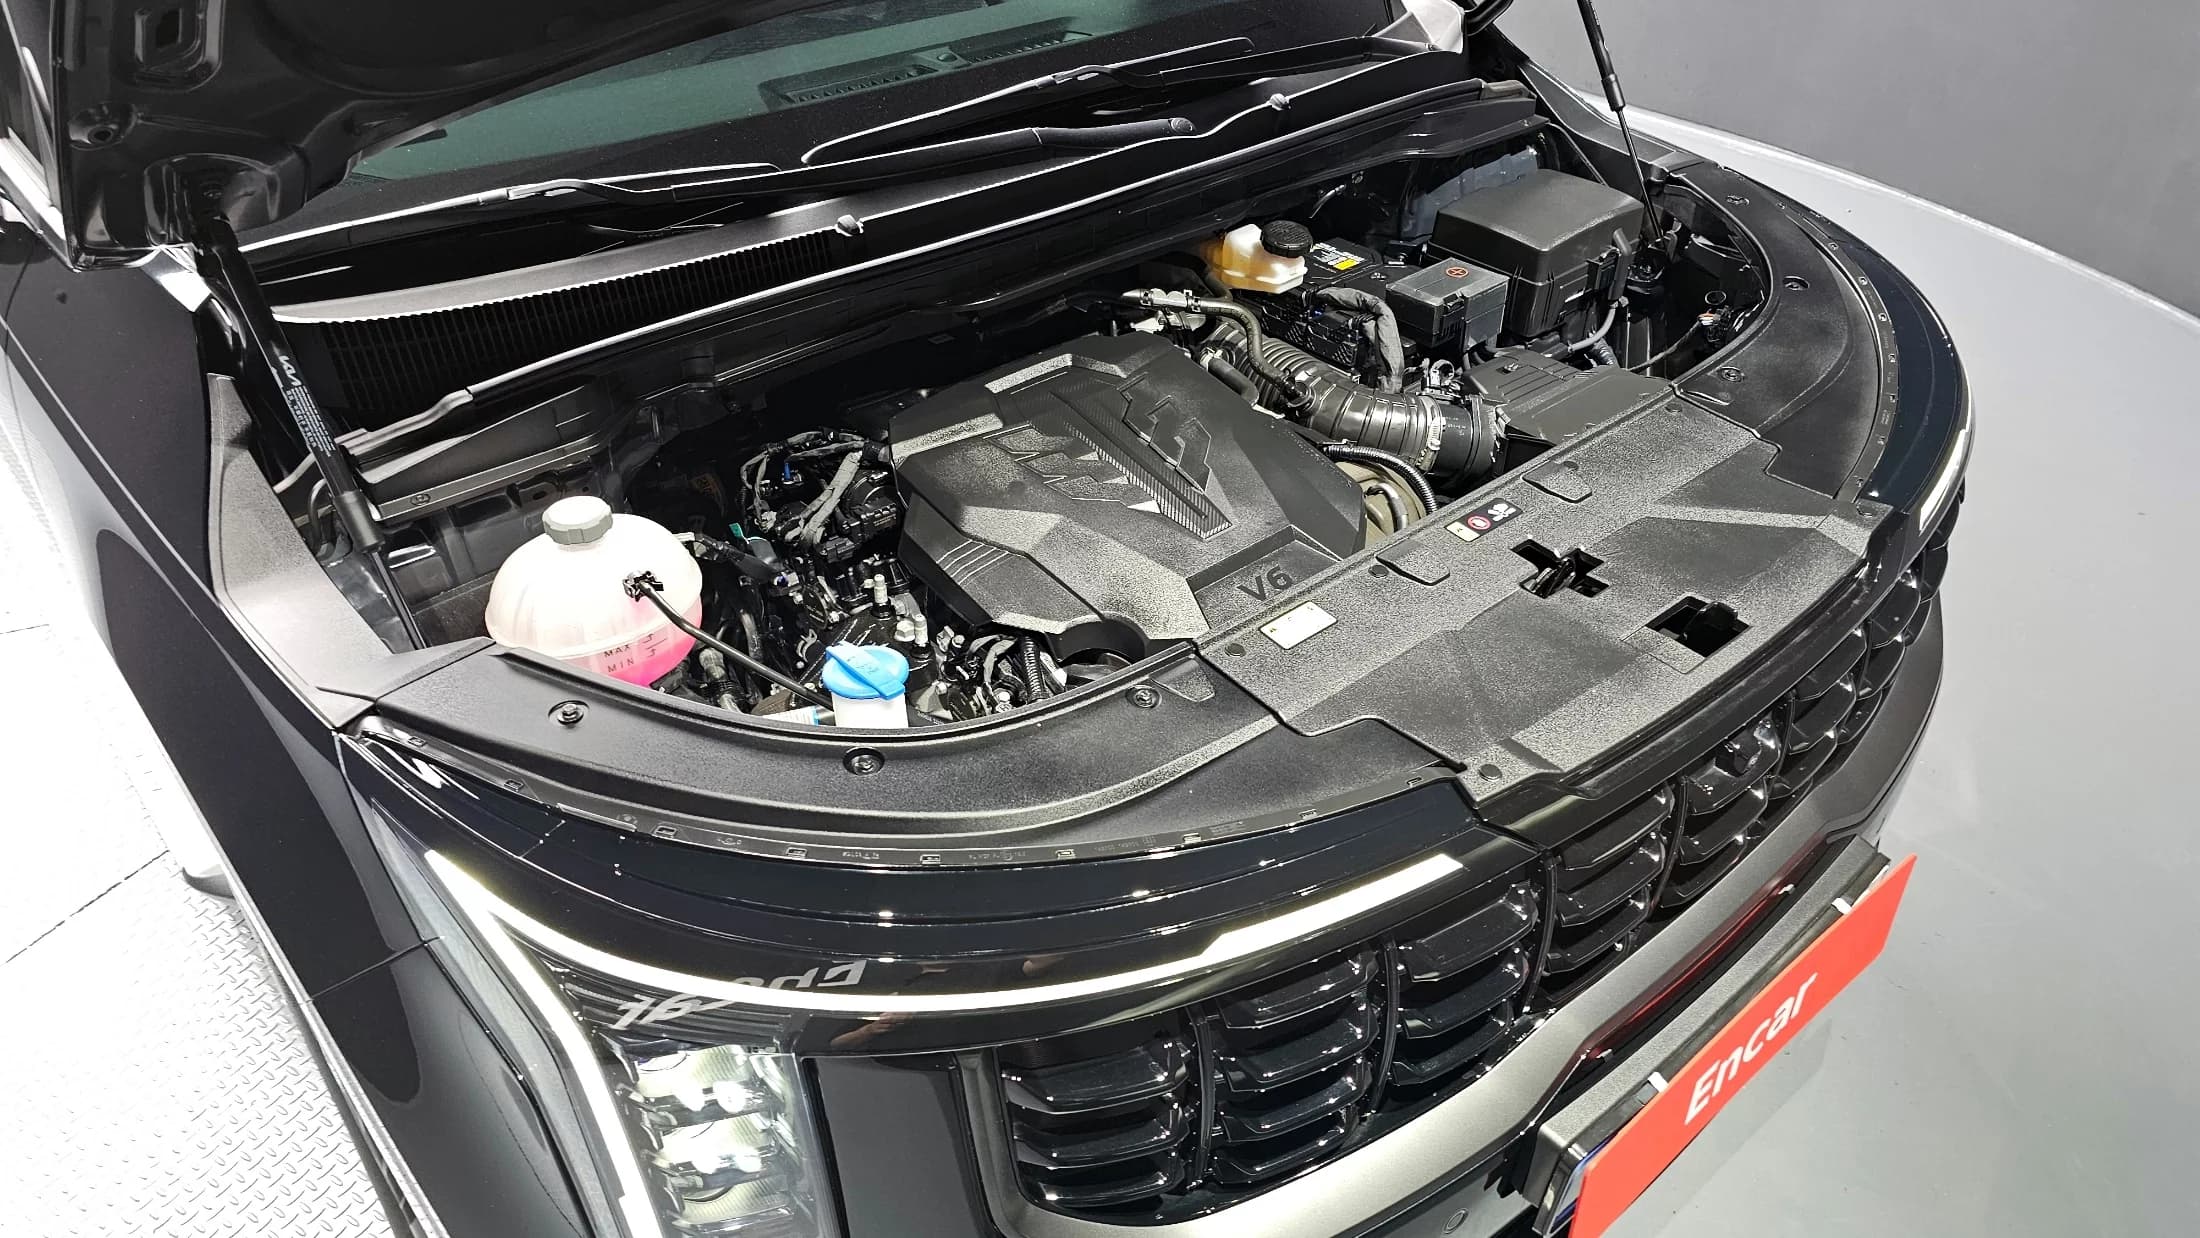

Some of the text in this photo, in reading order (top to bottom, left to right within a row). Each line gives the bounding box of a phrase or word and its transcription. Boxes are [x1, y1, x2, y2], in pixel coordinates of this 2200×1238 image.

[1236, 564, 1293, 601] V6
[603, 644, 631, 657] MAX
[607, 658, 634, 673] MIN
[1684, 971, 1818, 1126] Encar
